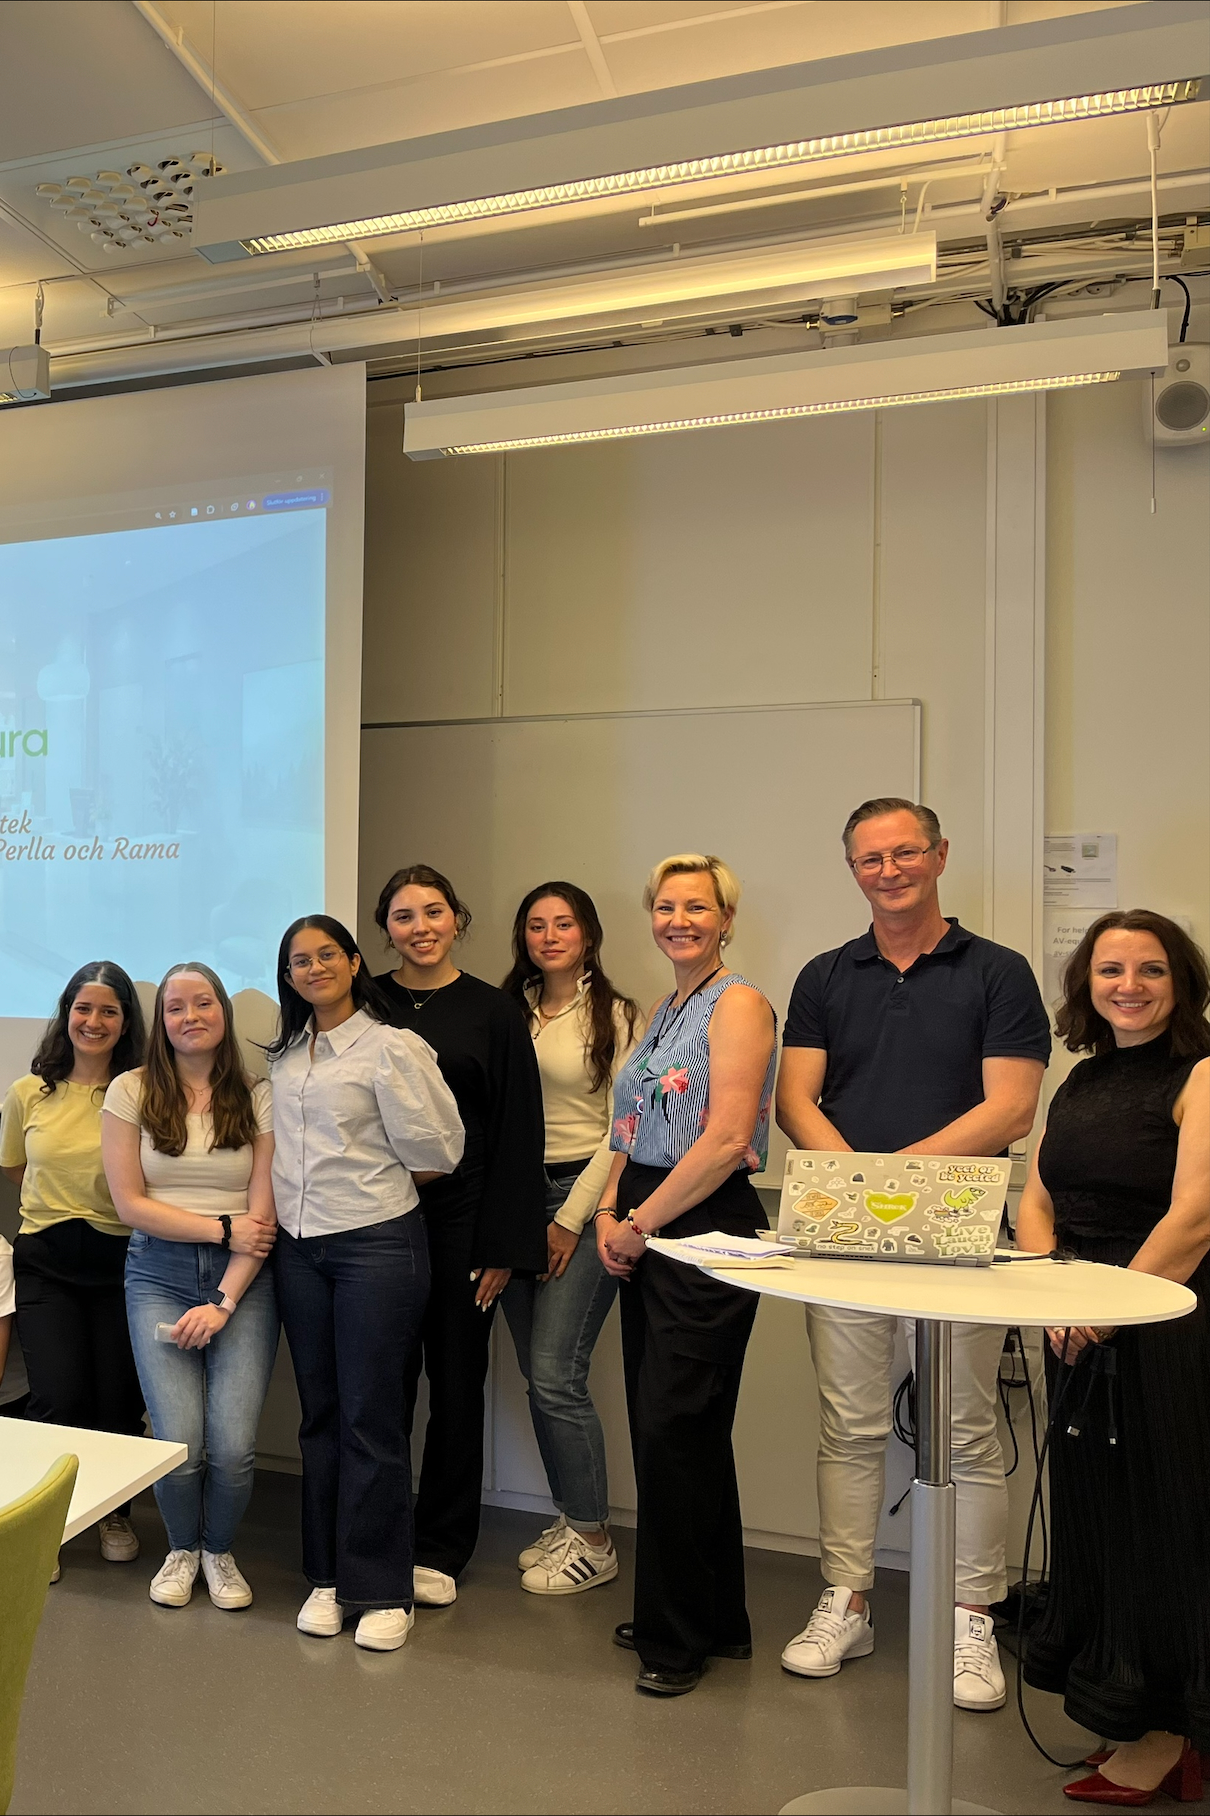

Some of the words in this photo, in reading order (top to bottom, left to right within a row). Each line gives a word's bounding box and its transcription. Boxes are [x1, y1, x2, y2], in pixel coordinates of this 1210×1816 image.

[63, 836, 103, 860] och
[111, 837, 180, 860] Rama
[979, 1166, 994, 1174] or
[940, 1172, 955, 1181] be
